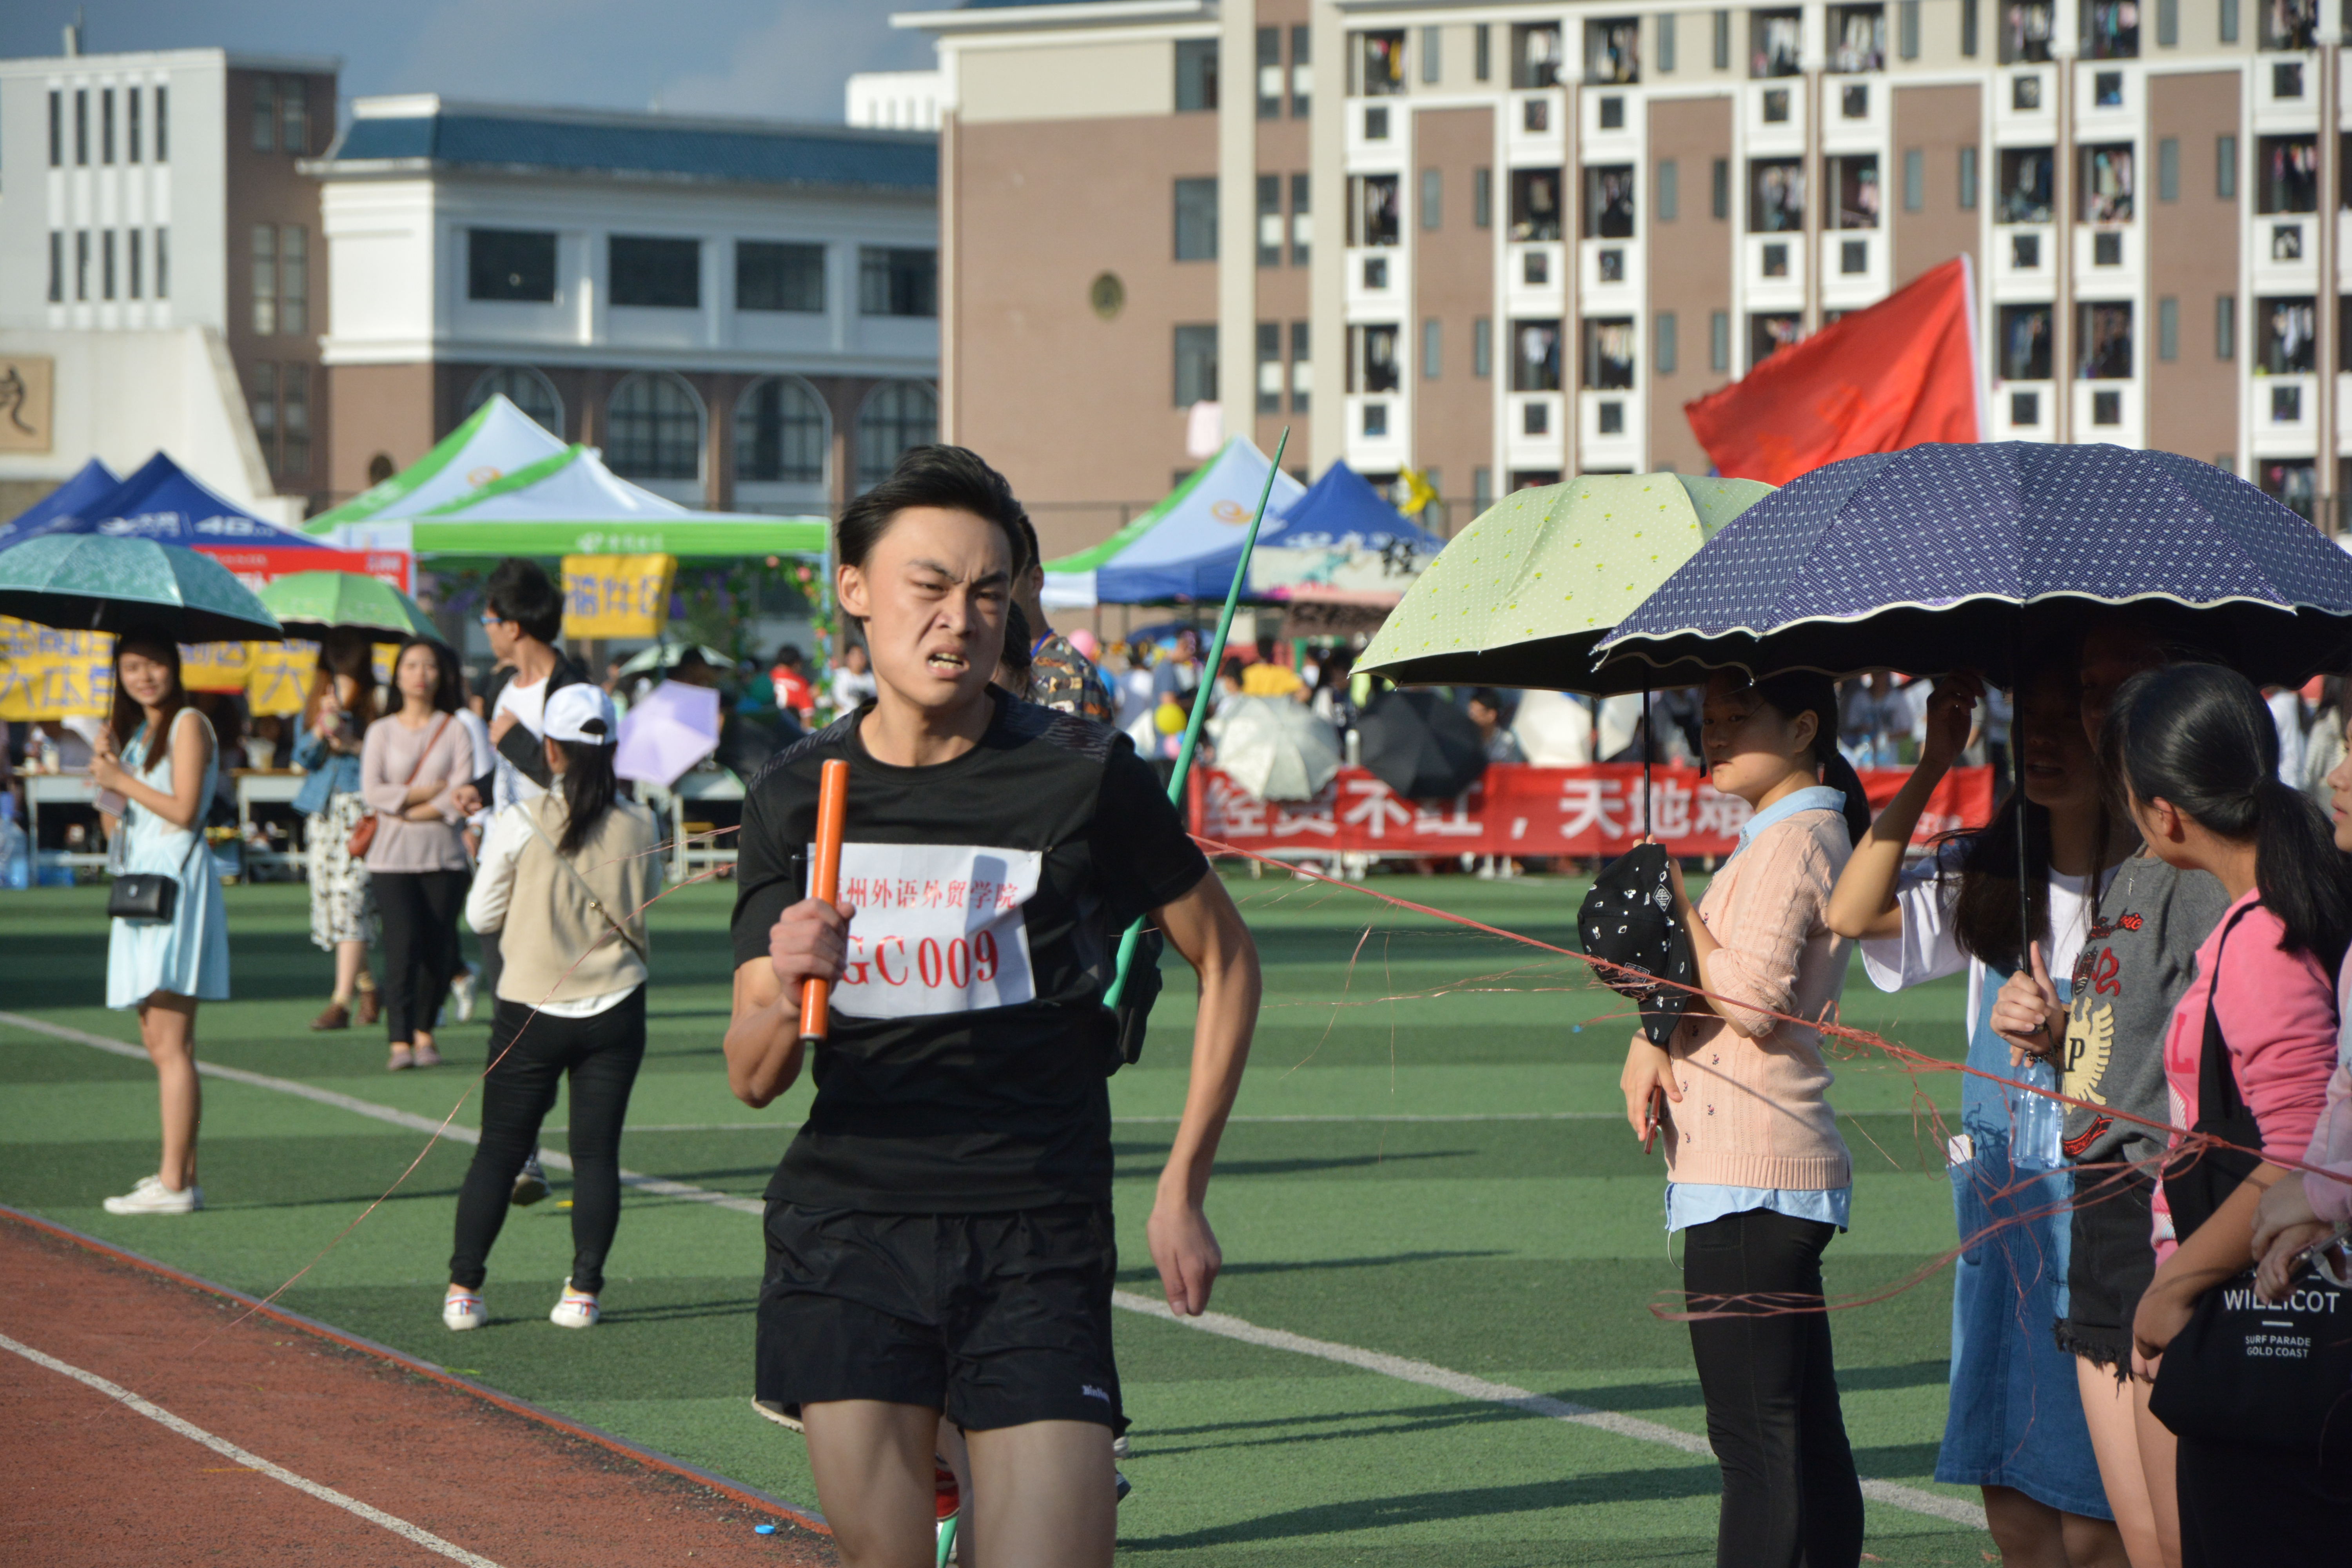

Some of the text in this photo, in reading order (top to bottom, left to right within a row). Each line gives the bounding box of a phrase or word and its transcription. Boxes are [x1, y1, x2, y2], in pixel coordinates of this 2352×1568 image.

[842, 929, 999, 988] GC009
[2064, 1038, 2085, 1072] P
[2245, 1335, 2312, 1346] SURF PARADE
[2247, 1347, 2309, 1358] GOLD COAST
